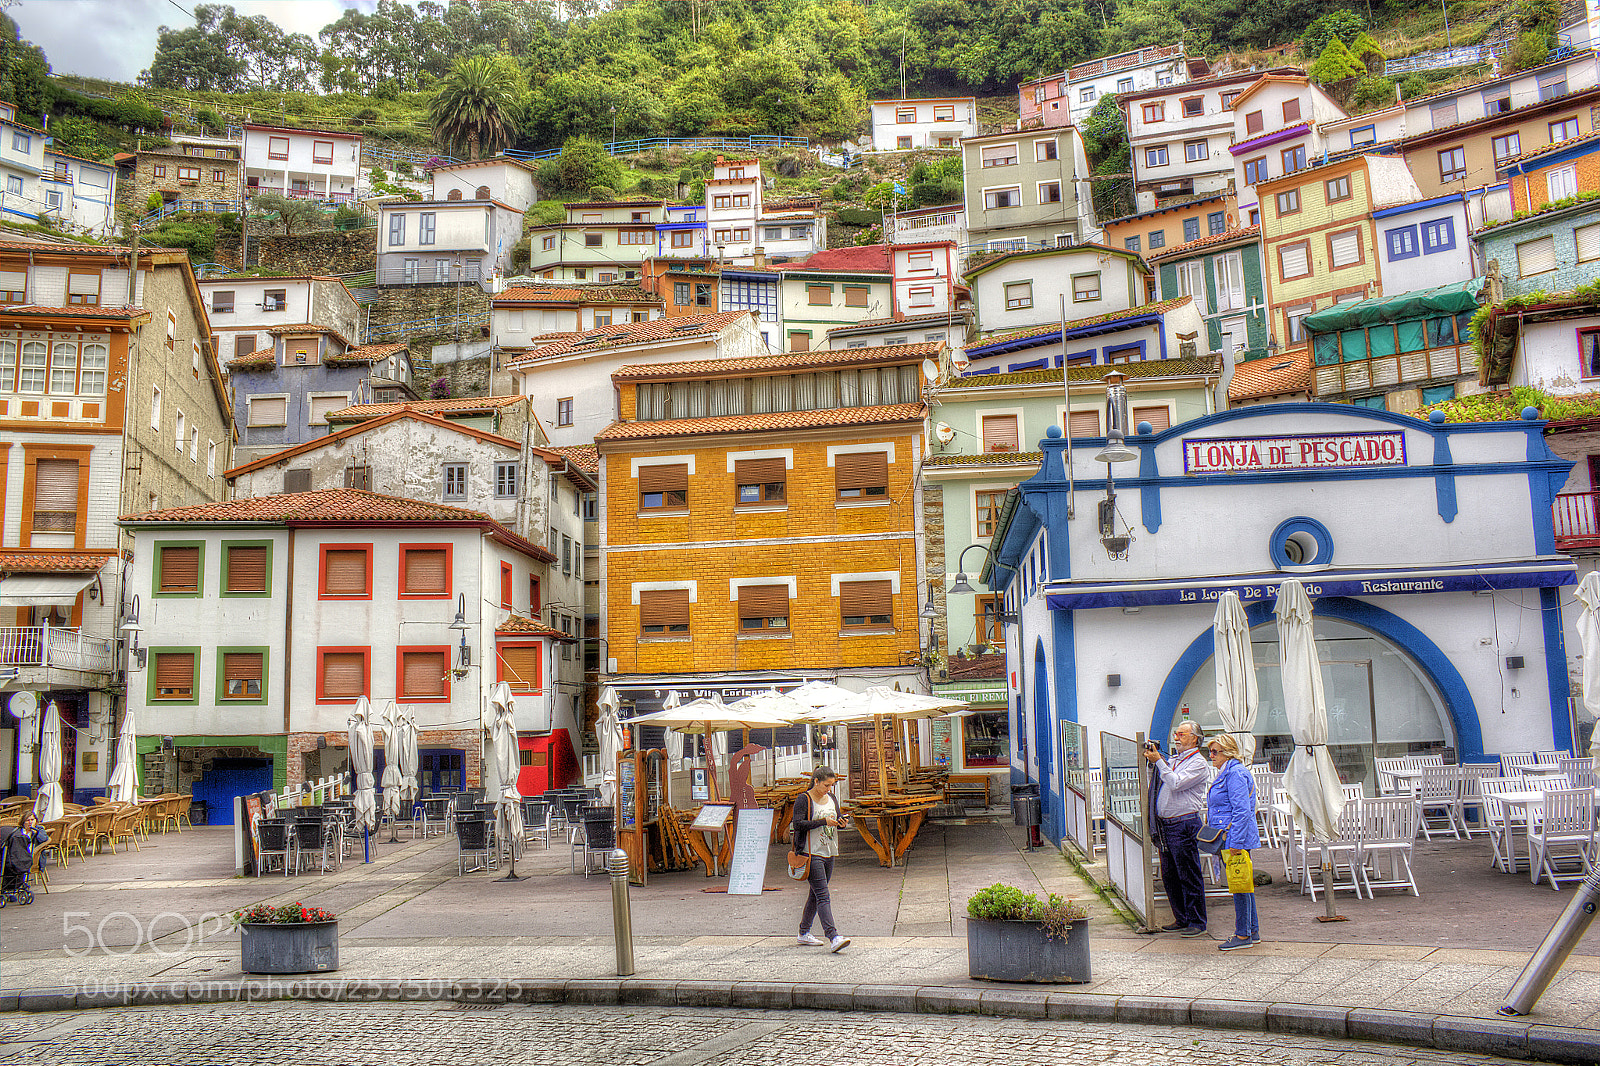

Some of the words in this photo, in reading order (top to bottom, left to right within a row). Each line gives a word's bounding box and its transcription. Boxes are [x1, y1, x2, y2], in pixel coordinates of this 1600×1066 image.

[1193, 444, 1262, 468] LONJA
[1269, 445, 1293, 465] DE
[1299, 438, 1396, 464] PESCADO
[1180, 589, 1197, 602] La
[1201, 588, 1240, 600] Lona
[1243, 586, 1262, 599] De
[1360, 578, 1444, 593] Restaurante
